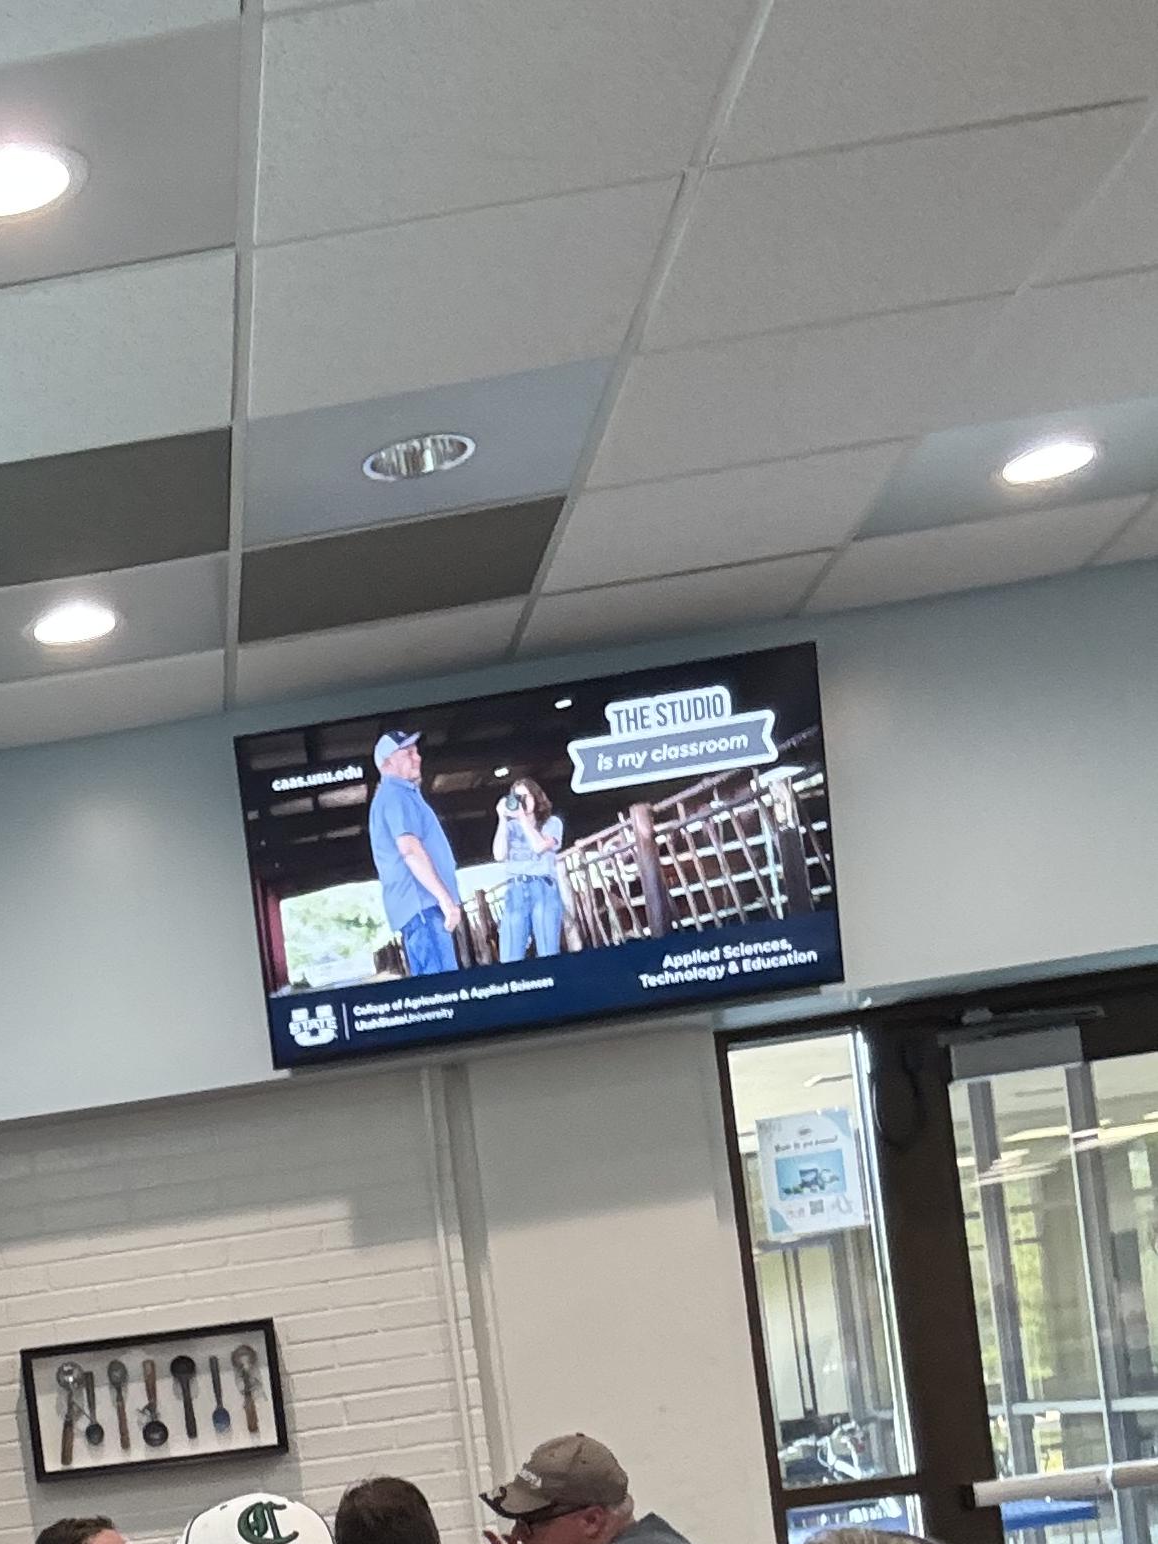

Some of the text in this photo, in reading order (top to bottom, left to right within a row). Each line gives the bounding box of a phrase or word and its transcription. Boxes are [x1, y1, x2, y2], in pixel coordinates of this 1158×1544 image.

[612, 693, 725, 734] THE STUDIO
[597, 734, 749, 771] is my classroom
[638, 949, 819, 989] Technology & Education
[662, 938, 793, 970] Applied Sciences,
[288, 1016, 337, 1035] STATE
